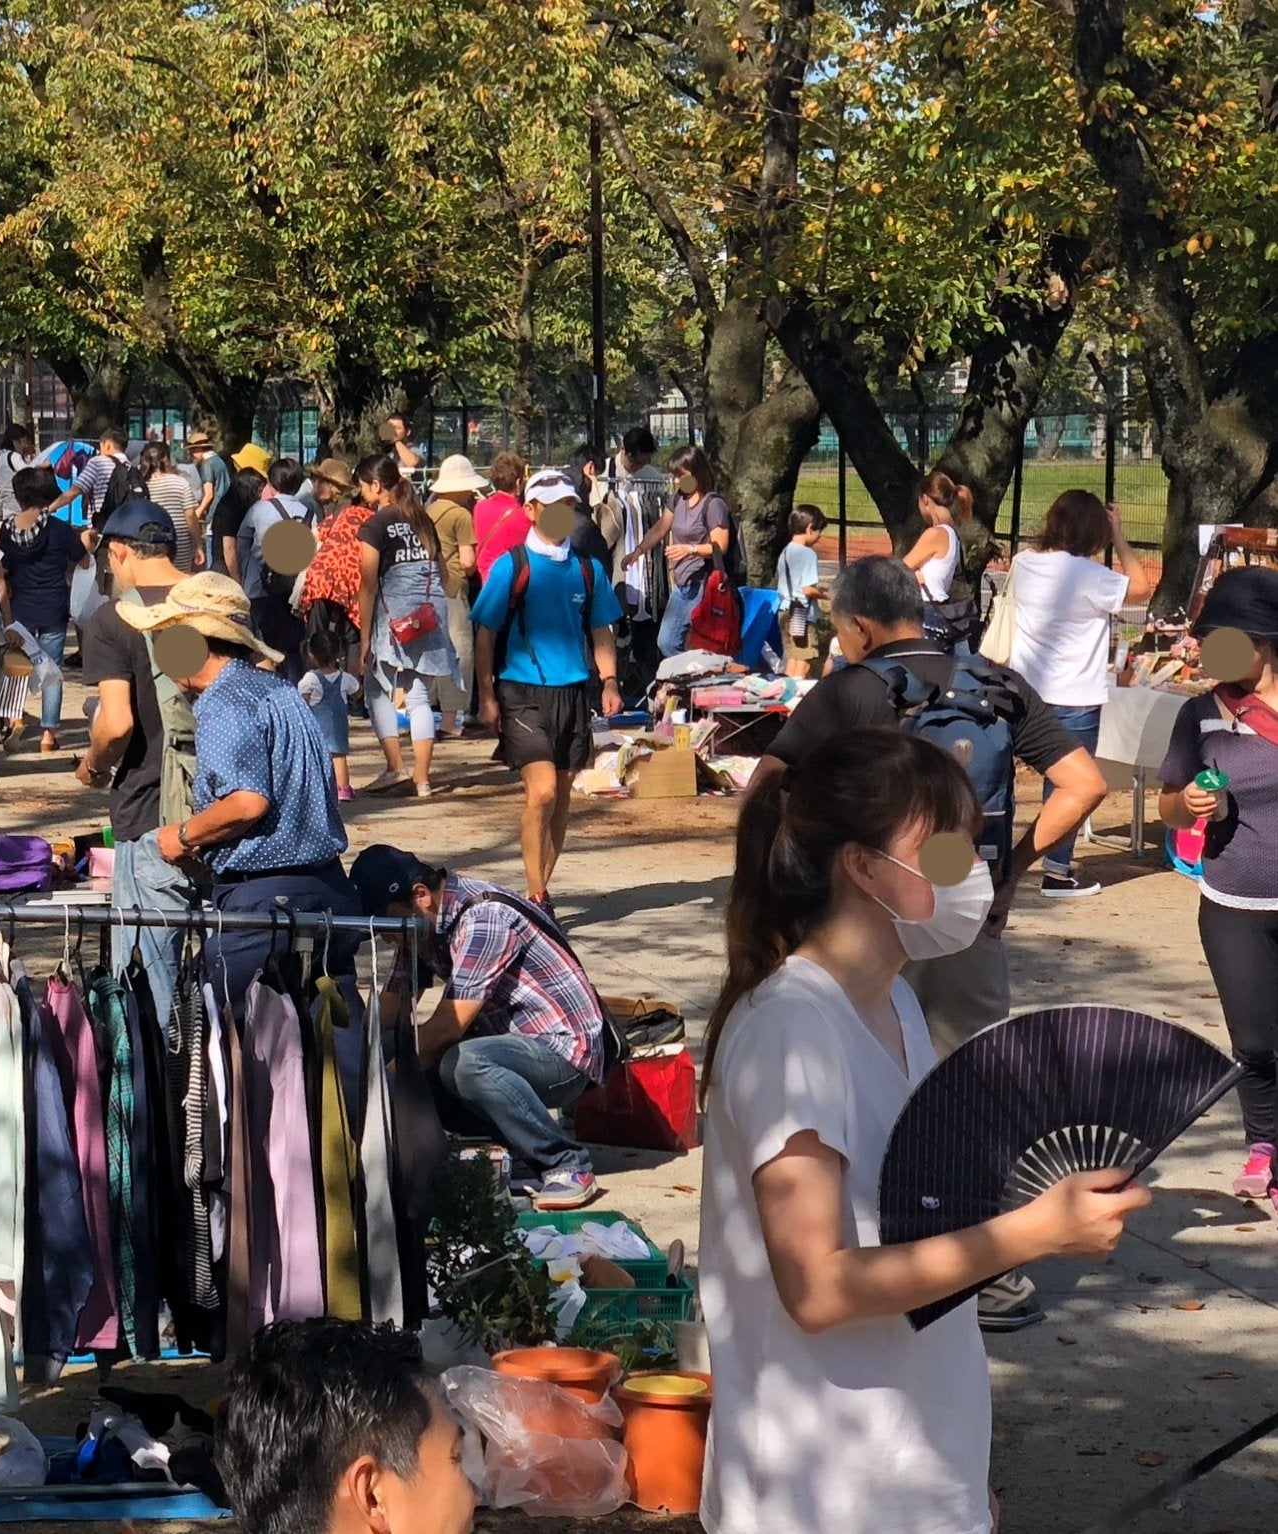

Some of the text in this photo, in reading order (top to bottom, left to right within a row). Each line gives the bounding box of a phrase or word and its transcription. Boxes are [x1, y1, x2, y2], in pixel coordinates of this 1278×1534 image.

[387, 523, 413, 538] SER
[403, 535, 421, 547] YO
[395, 547, 429, 562] RIGH
